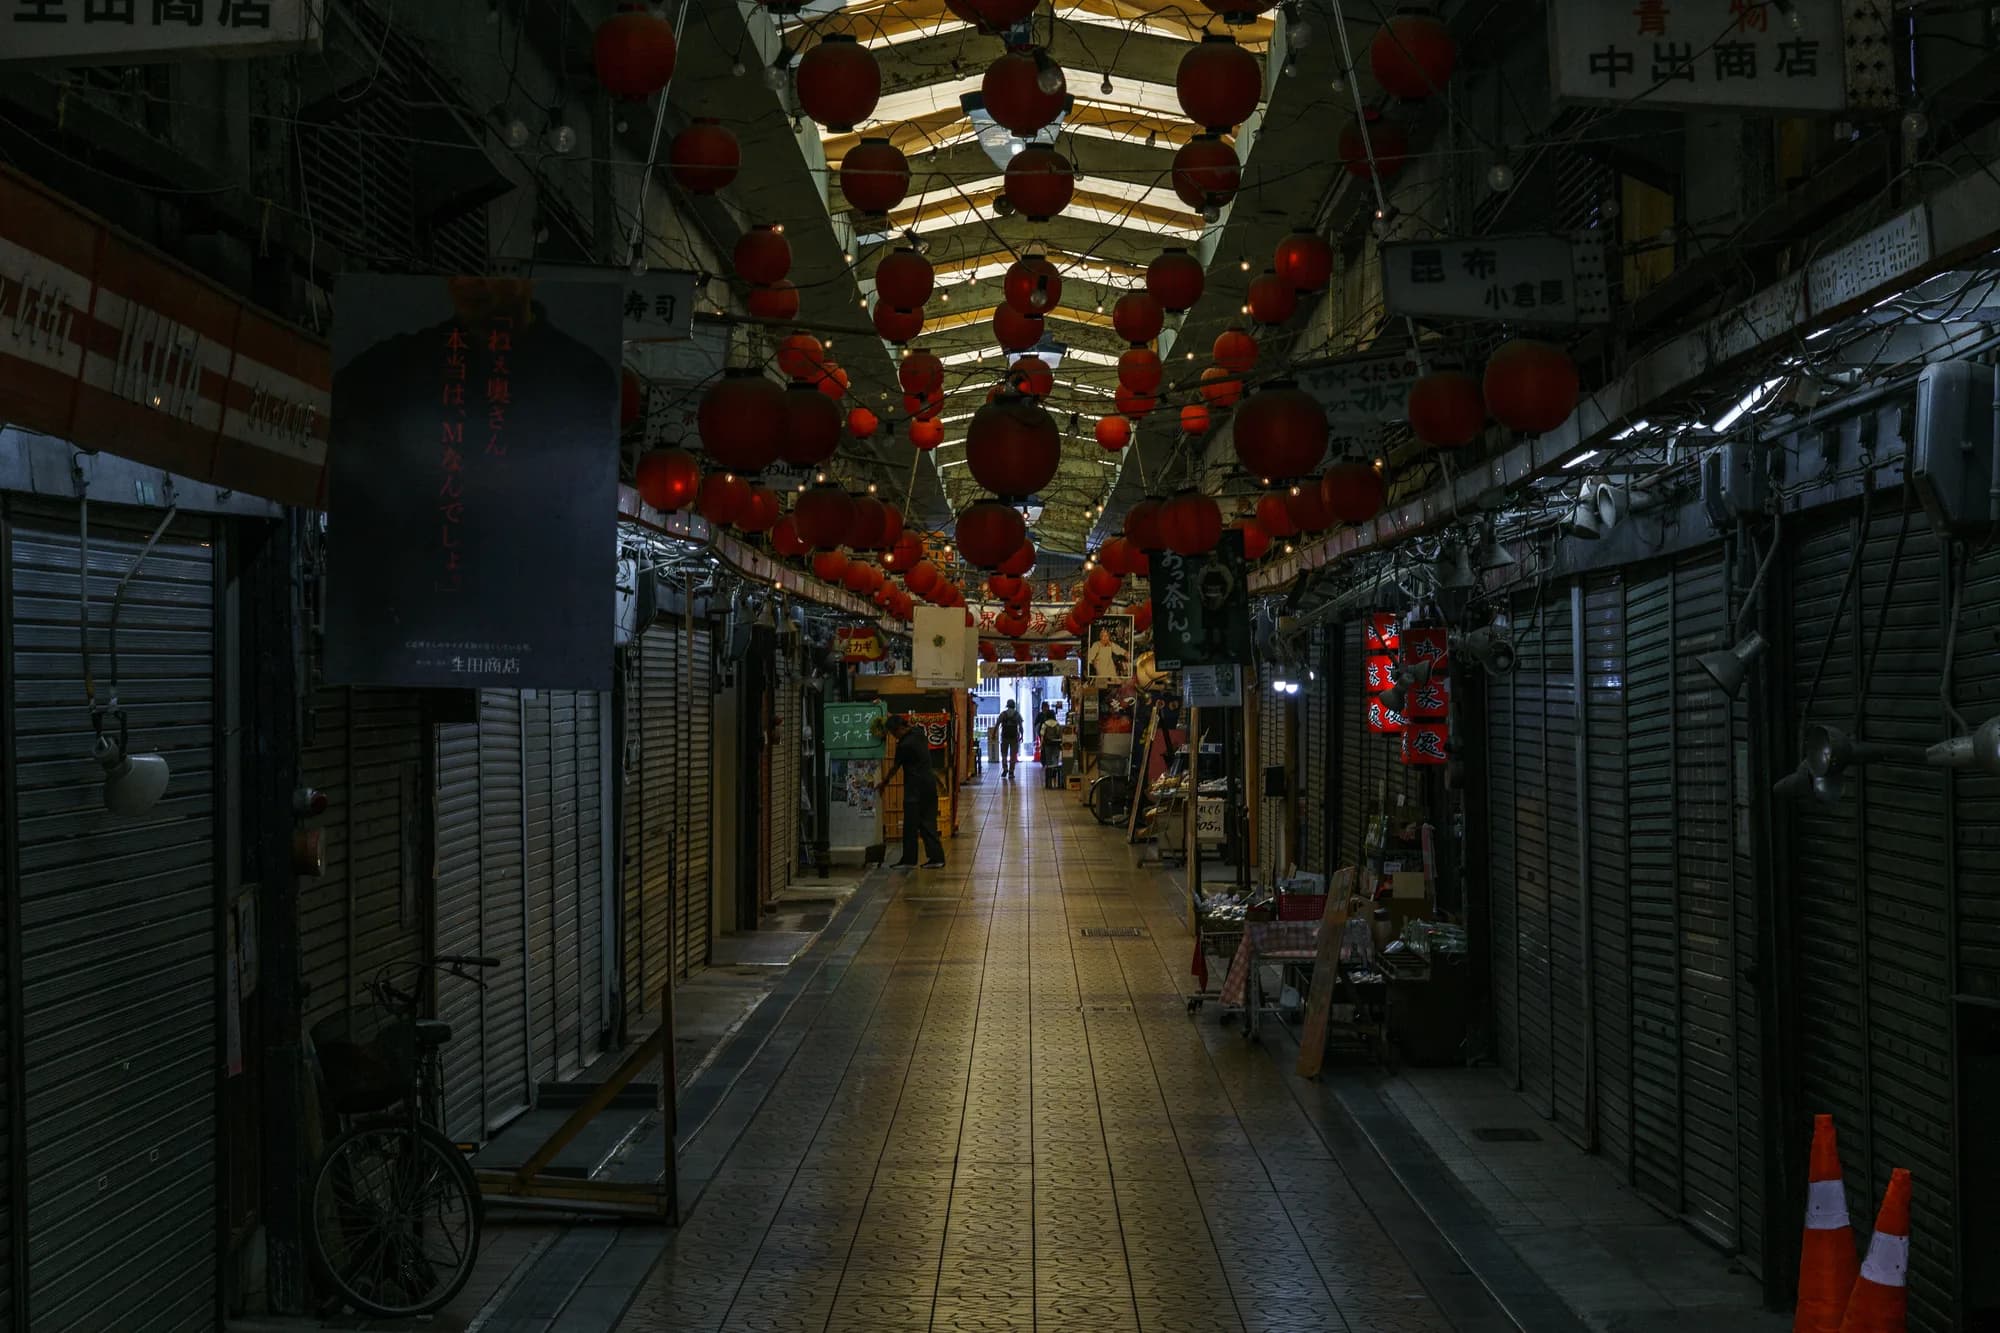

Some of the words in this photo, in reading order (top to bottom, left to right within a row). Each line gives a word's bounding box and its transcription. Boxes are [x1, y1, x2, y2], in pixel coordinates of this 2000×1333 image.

[1589, 38, 1819, 88] 中出商店
[1411, 248, 1498, 282] 昆布
[451, 656, 520, 674] 生田商店
